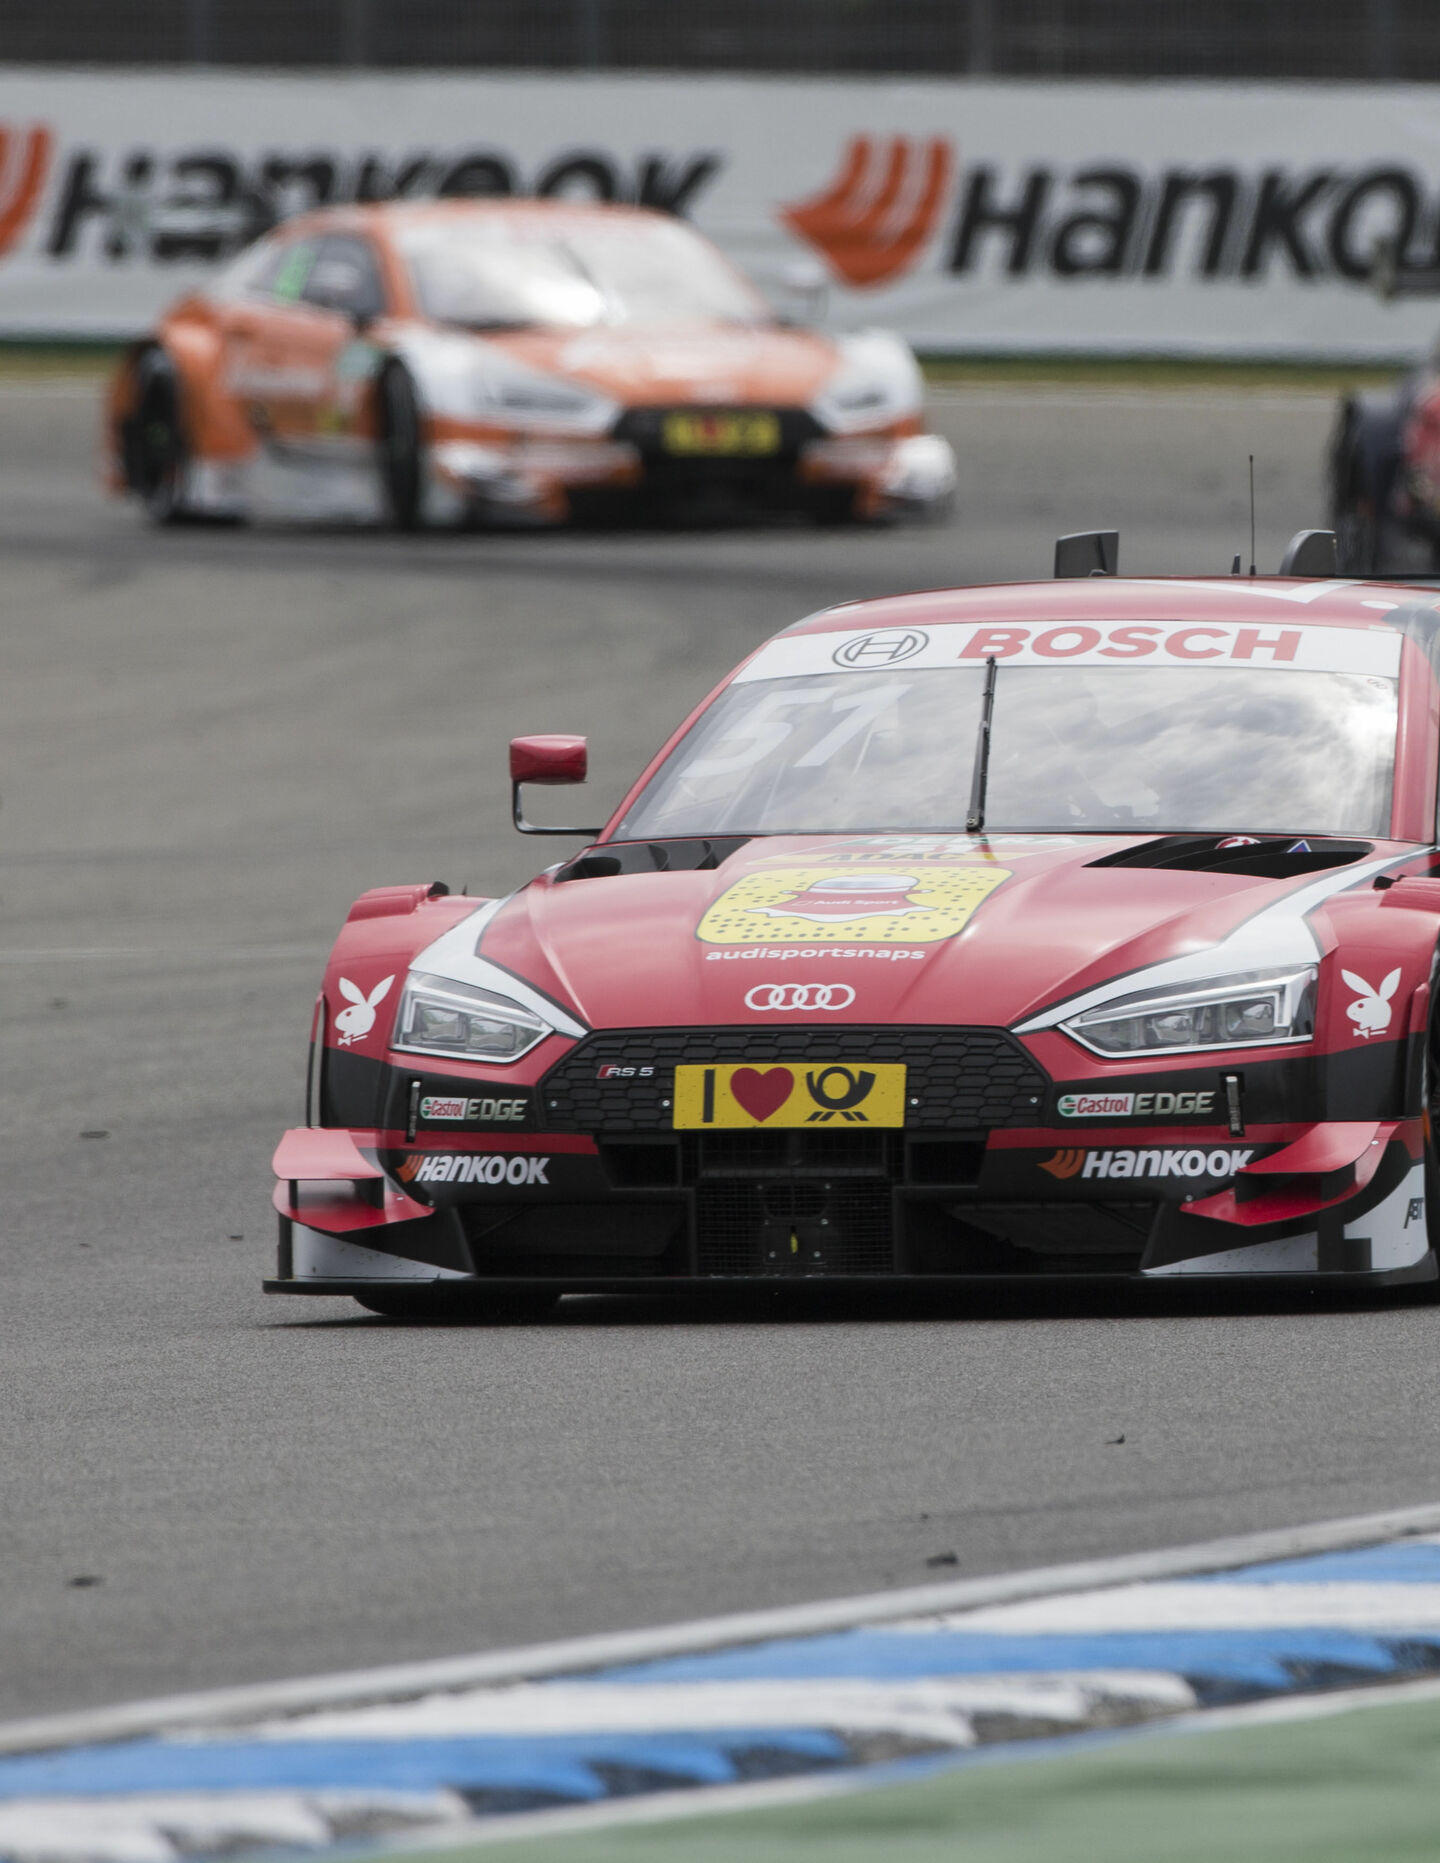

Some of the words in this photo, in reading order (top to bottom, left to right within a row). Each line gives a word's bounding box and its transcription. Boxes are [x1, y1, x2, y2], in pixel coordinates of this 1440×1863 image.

[958, 626, 1301, 661] BOSCH
[678, 682, 917, 779] 51
[818, 853, 963, 862] ADAC
[705, 948, 925, 961] audisportsnaps
[431, 1100, 464, 1117] Castrol
[465, 1098, 528, 1120] EDGE
[1077, 1096, 1129, 1113] Castrol
[1133, 1091, 1216, 1115] EDGE
